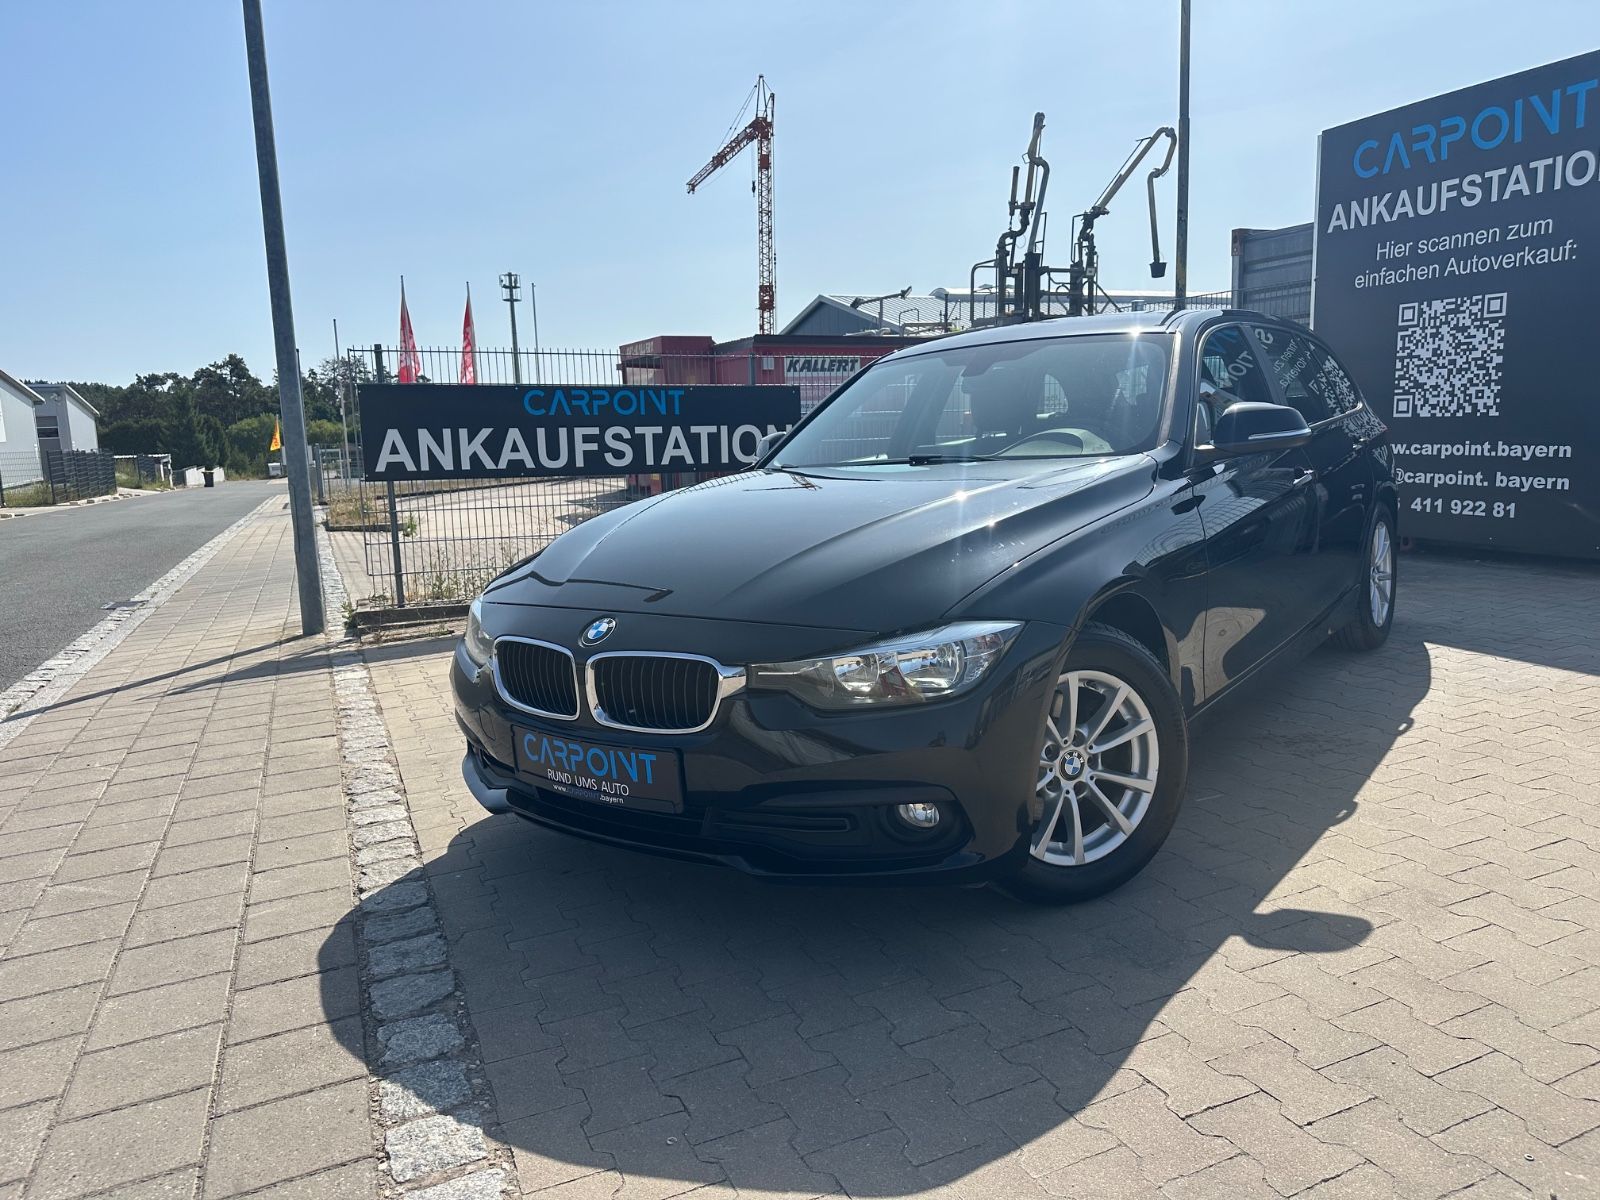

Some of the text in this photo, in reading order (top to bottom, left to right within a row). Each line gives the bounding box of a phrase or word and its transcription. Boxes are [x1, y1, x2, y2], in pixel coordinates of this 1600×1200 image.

[1353, 79, 1598, 178] CARPOINT
[1327, 150, 1600, 232] ANKAUFSTATIO
[1376, 218, 1553, 260] Hier scannen zum
[1355, 239, 1578, 288] einfachen Autoverkauf:
[787, 359, 858, 372] KALLERT
[524, 389, 685, 416] CARPOINT
[375, 424, 793, 473] ANKAUFSTATIO
[1496, 472, 1570, 492] bayern
[1410, 497, 1442, 514] 411
[1450, 500, 1486, 517] 922
[1493, 502, 1516, 519] 81
[523, 733, 657, 784] CARPOINT
[1064, 751, 1084, 764] BMW
[547, 768, 629, 796] RUND UMS AUTO
